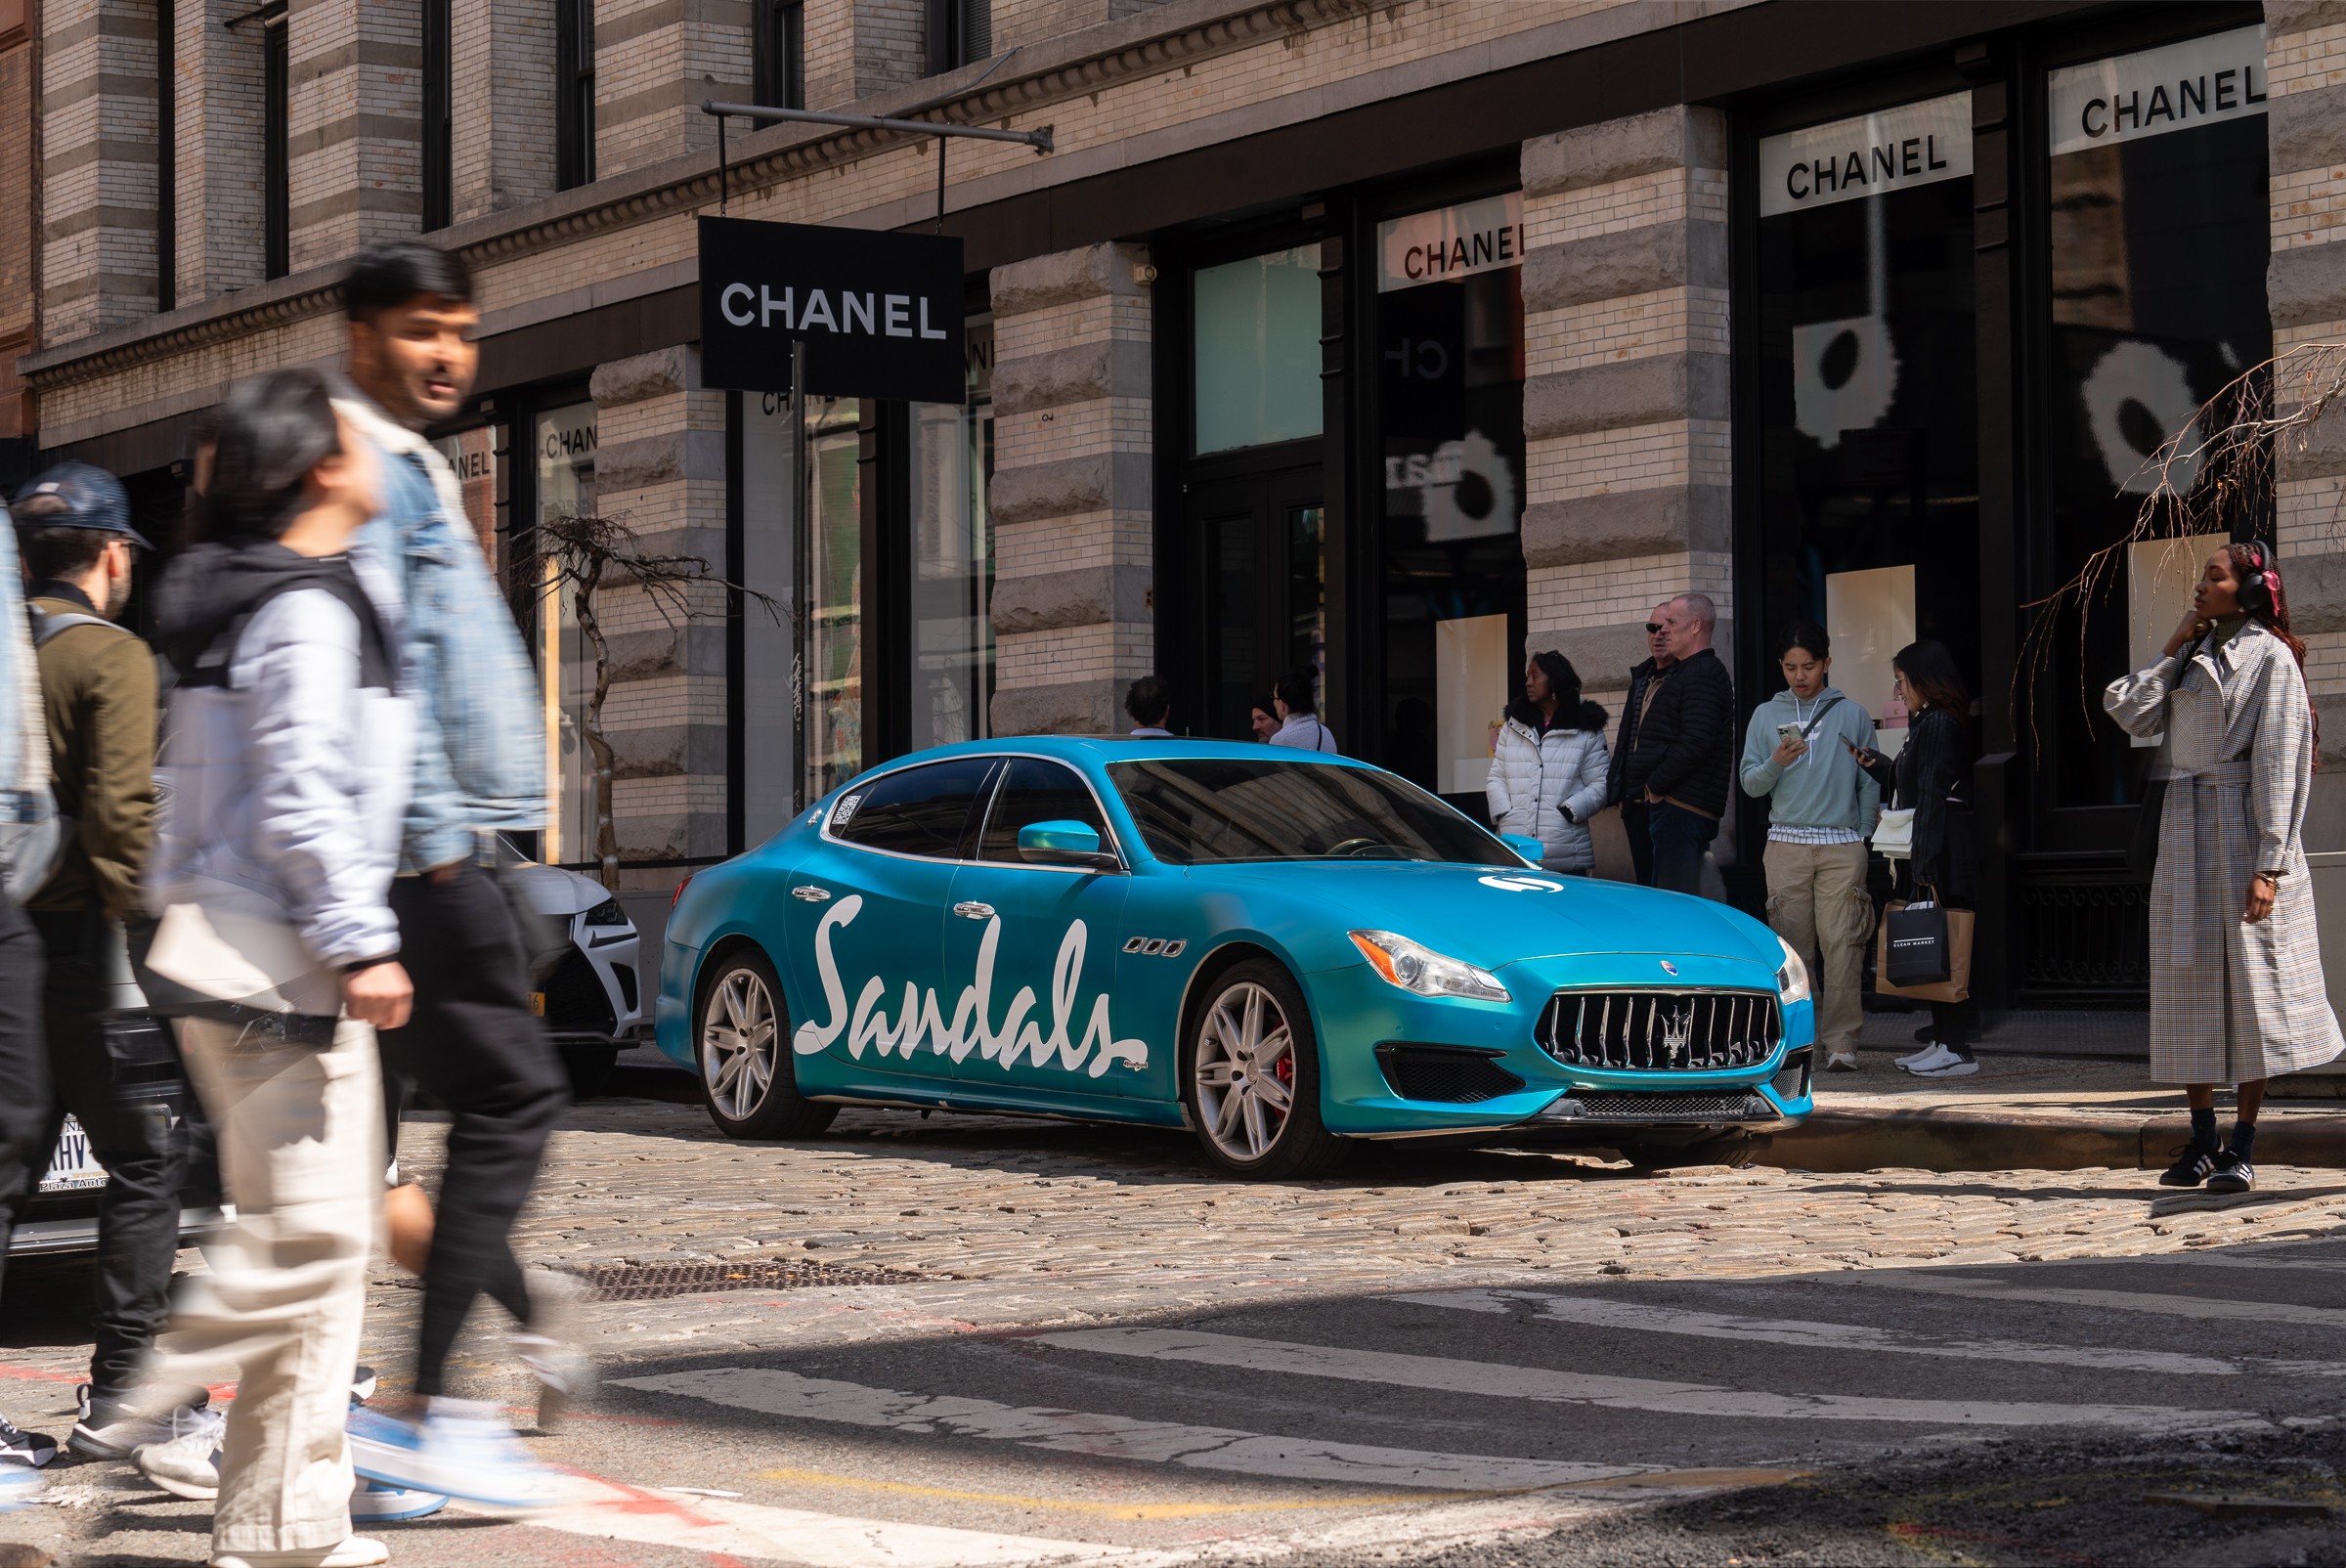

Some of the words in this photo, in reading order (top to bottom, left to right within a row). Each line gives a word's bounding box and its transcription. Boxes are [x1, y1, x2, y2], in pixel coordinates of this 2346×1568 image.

[2082, 65, 2268, 139] CHANEL
[1787, 134, 1947, 199] CHANEL
[720, 283, 946, 340] CHANEL
[794, 894, 1149, 1077] Sandals
[40, 1181, 73, 1192] Plaza
[79, 1178, 108, 1187] Auto
